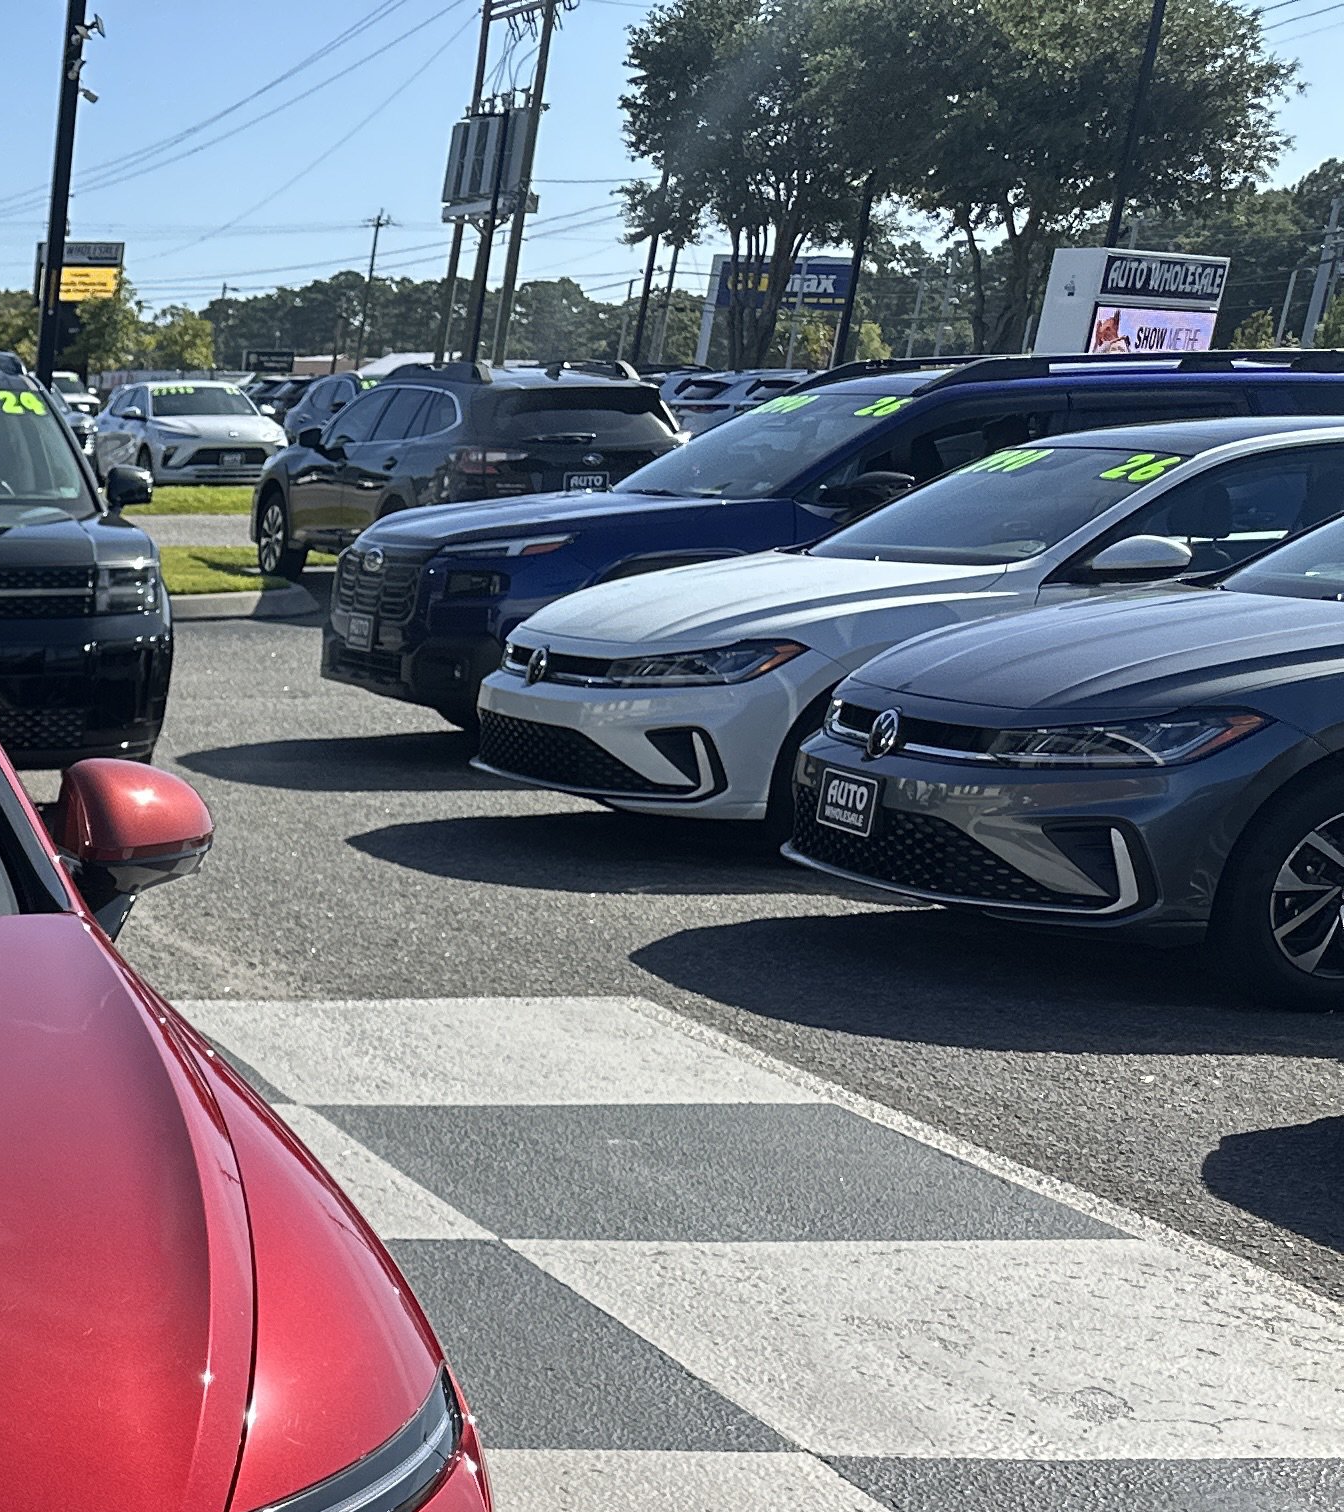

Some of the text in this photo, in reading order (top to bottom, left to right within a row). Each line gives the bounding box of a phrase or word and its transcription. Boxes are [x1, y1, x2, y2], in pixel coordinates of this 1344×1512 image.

[1108, 260, 1223, 295] AUTO WHOLESALE
[1135, 326, 1201, 351] SHOW ME THE
[853, 396, 914, 417] 26
[1099, 453, 1182, 483] 26
[570, 475, 603, 487] AUTO
[826, 779, 869, 811] AUTO
[824, 804, 864, 827] WHOLESALE
